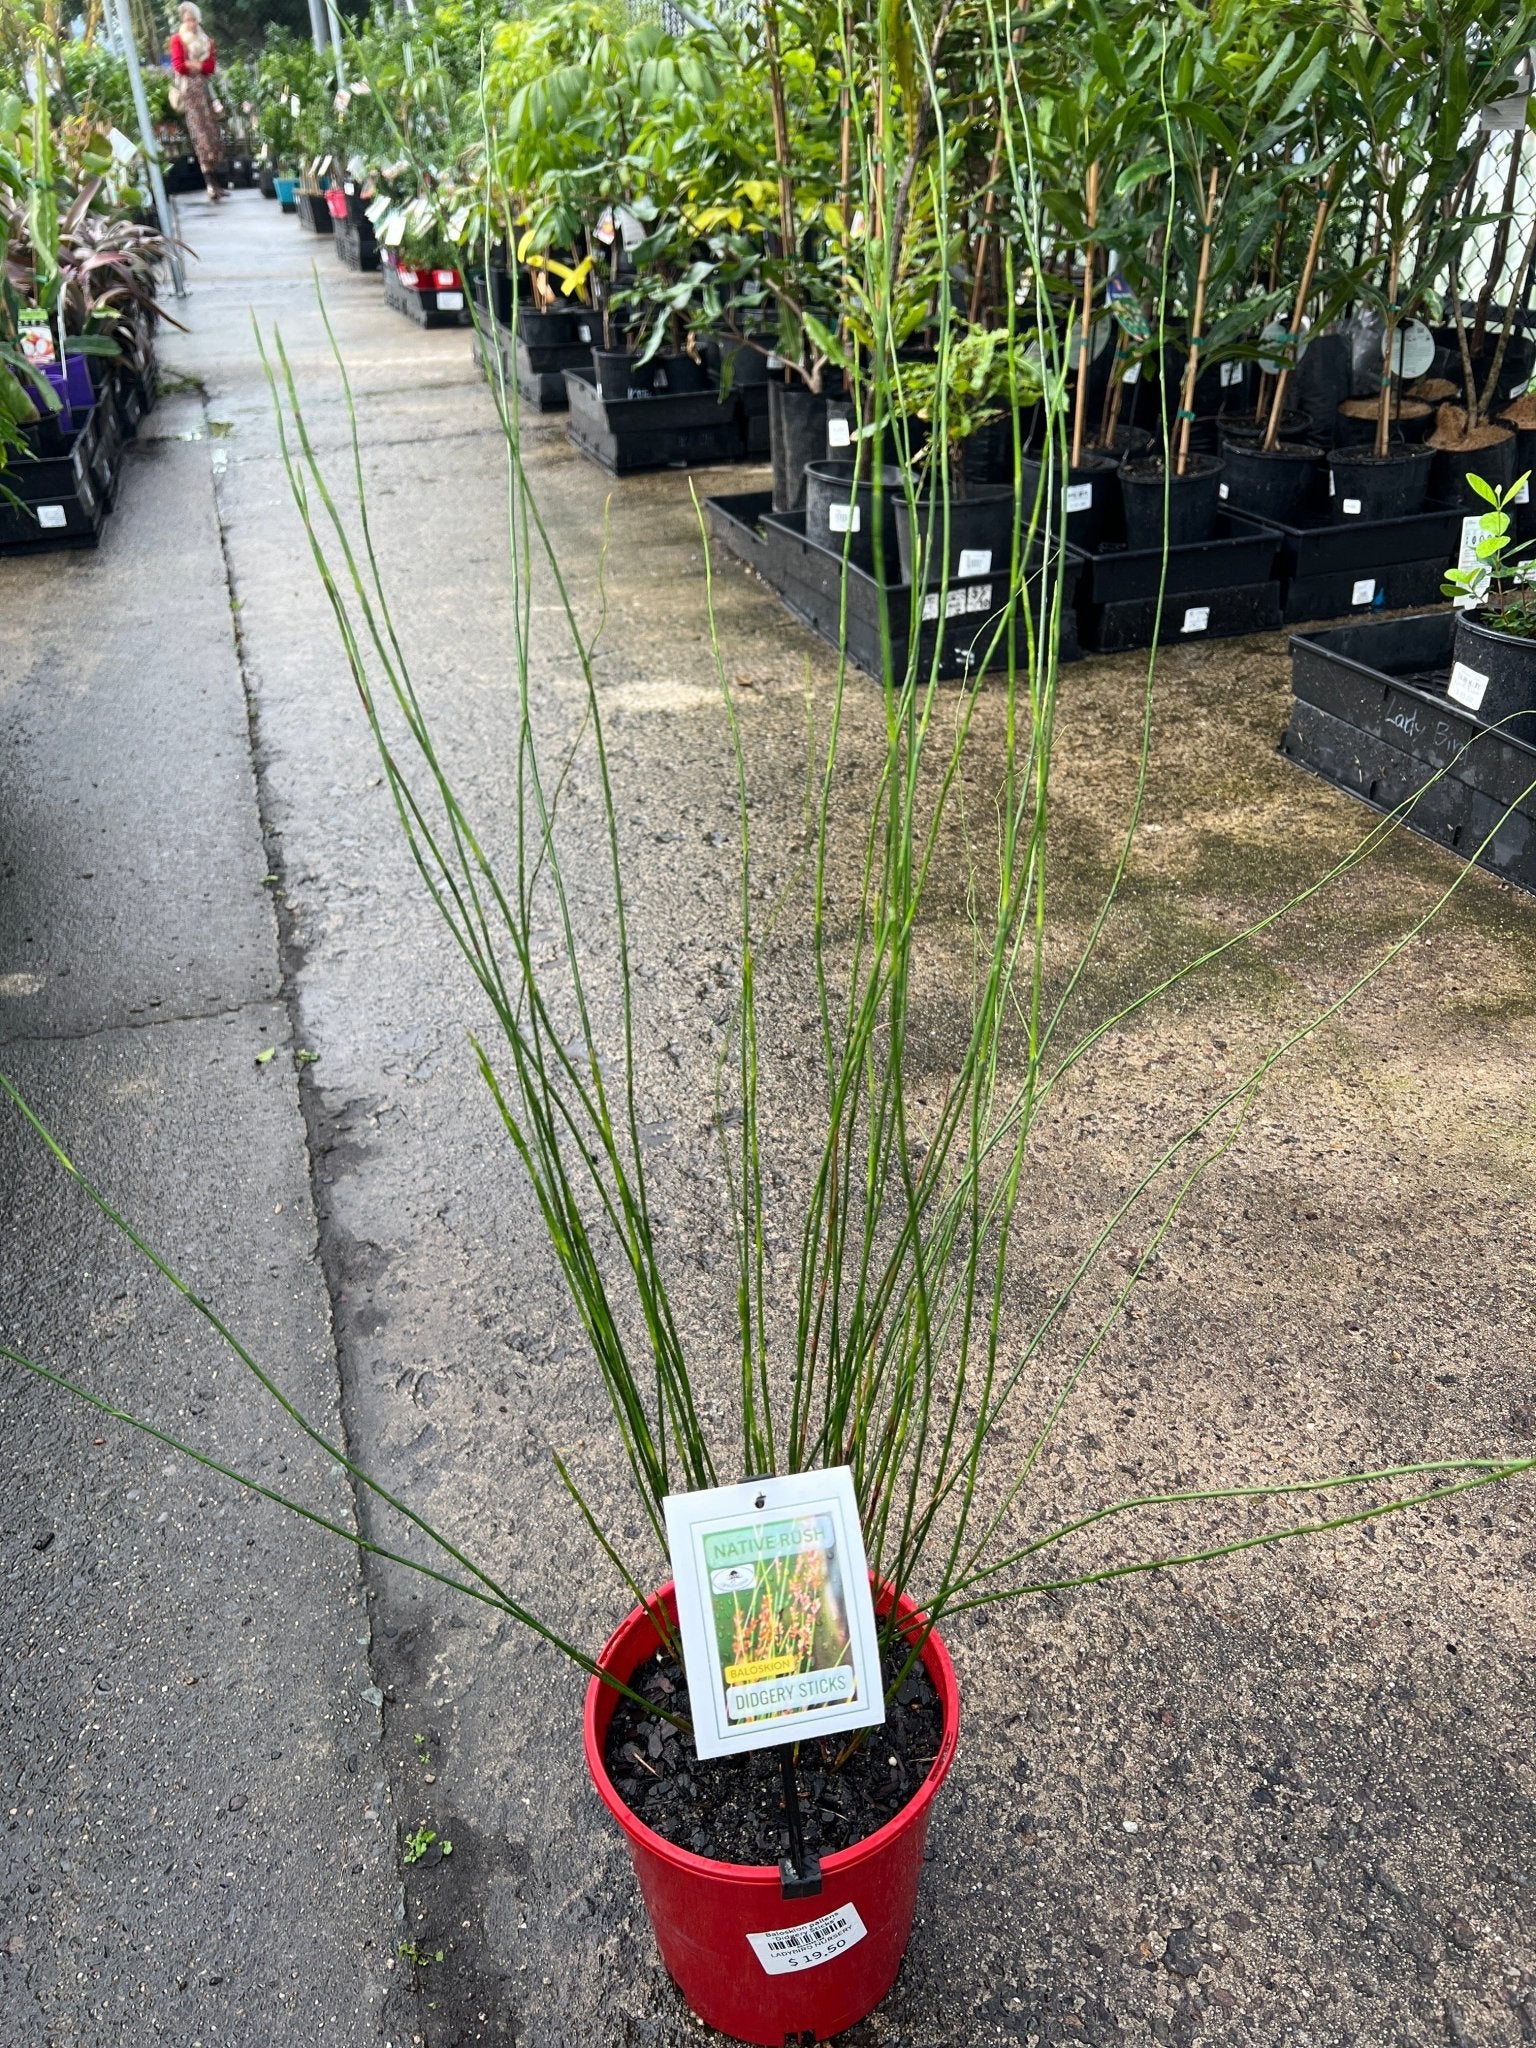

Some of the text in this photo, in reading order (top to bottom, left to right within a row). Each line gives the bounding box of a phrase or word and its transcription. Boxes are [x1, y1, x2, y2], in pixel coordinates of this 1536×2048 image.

[1384, 695, 1426, 742] Lady
[713, 1526, 826, 1560] NATIVE RUSH
[729, 1658, 790, 1680] BALOSKION
[735, 1675, 847, 1711] DIDGERY STICKS
[765, 1912, 839, 1938] Baloskion pallens
[771, 1944, 813, 1958] LADYBIRD
[814, 1924, 853, 1948] NURSERY
[788, 1957, 799, 1967] $
[803, 1938, 847, 1963] 19.50
